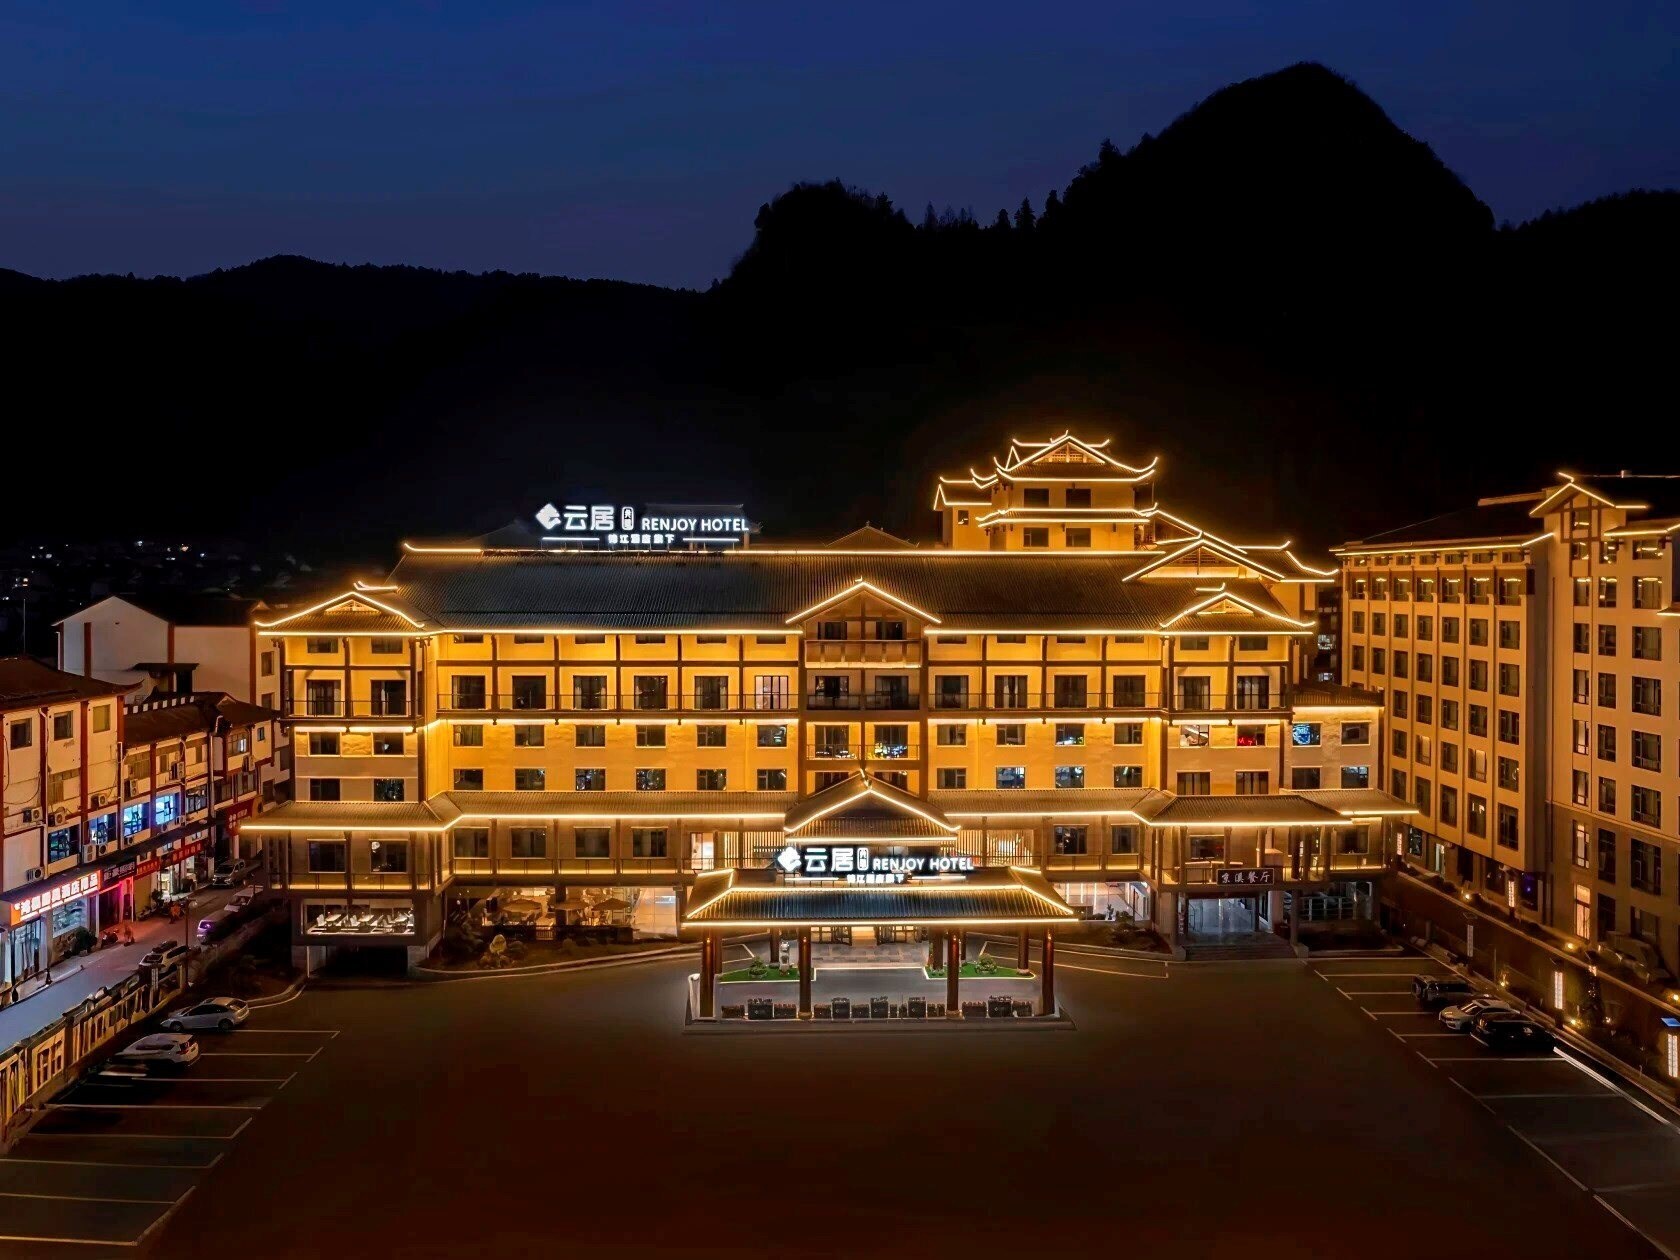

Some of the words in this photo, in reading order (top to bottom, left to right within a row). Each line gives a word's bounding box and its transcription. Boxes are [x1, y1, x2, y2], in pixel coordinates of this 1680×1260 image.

[563, 505, 615, 531] 云居
[641, 518, 697, 531] RENJOY
[701, 518, 749, 531] HOTEL
[804, 847, 854, 871] 云居
[873, 857, 925, 870] RENJOY
[930, 857, 974, 870] HOTEL
